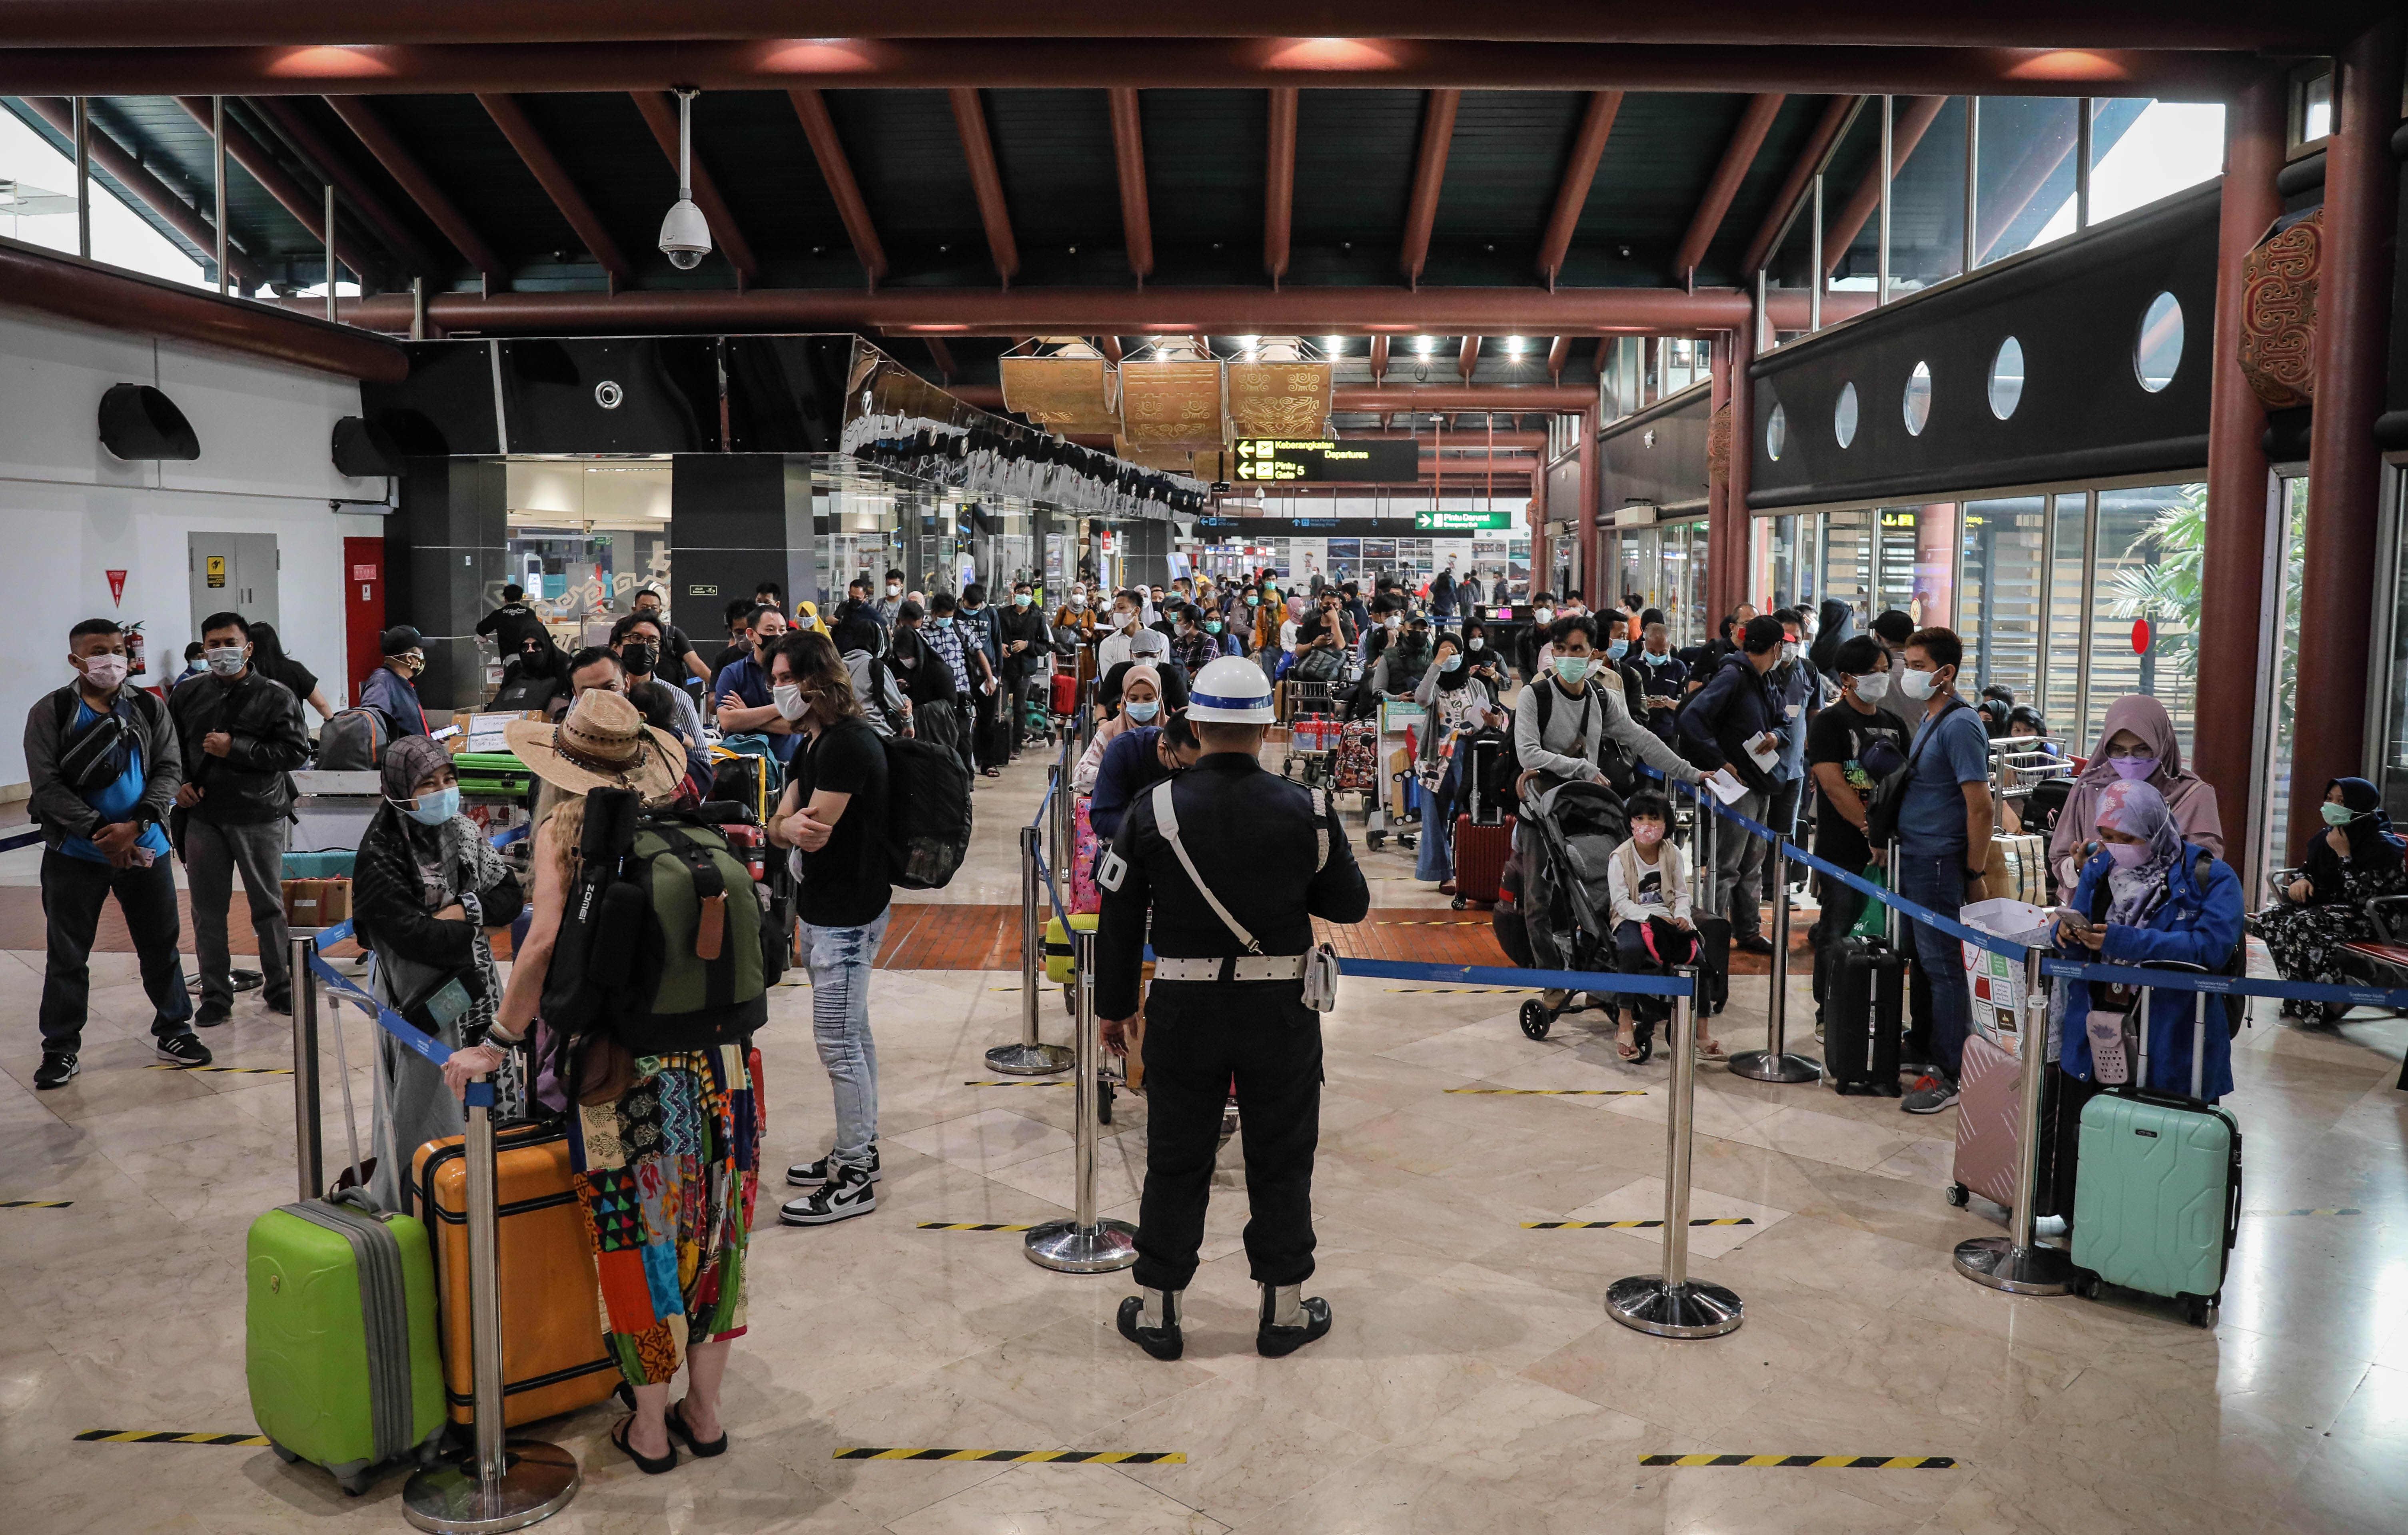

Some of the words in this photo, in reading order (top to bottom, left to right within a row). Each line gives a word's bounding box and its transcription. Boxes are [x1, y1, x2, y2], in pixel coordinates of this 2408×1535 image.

[1275, 441, 1334, 451] Keberangkatan
[1324, 450, 1368, 459] Departures
[1275, 471, 1295, 479] Gate
[1297, 466, 1305, 475] 5
[1966, 516, 1983, 525] tang
[578, 884, 595, 920] ZOMEI
